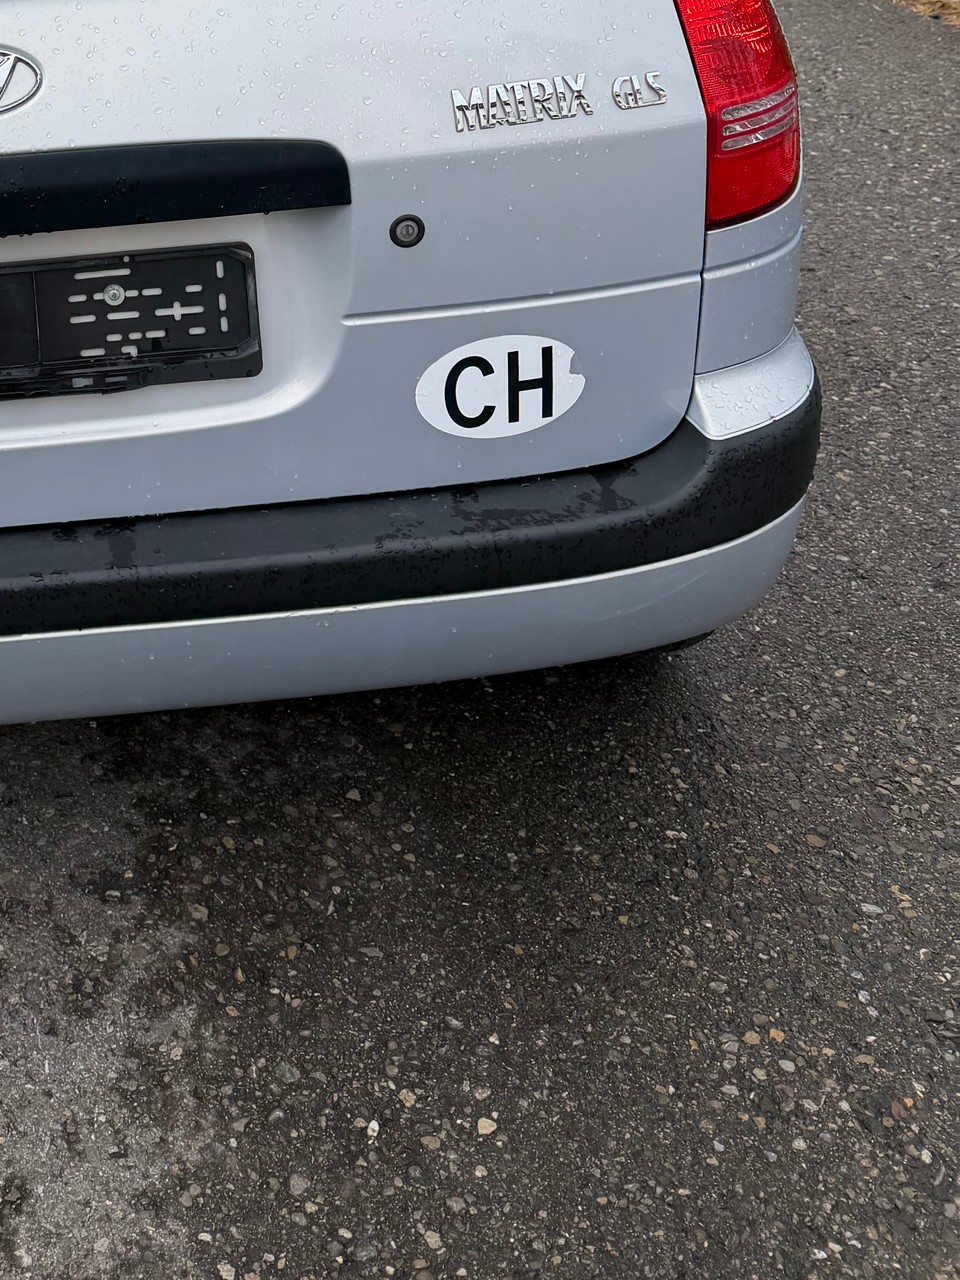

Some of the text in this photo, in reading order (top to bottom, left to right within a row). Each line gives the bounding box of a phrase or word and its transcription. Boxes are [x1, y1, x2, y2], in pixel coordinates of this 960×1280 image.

[450, 70, 668, 133] MATRIX GLS
[444, 345, 553, 429] CH
